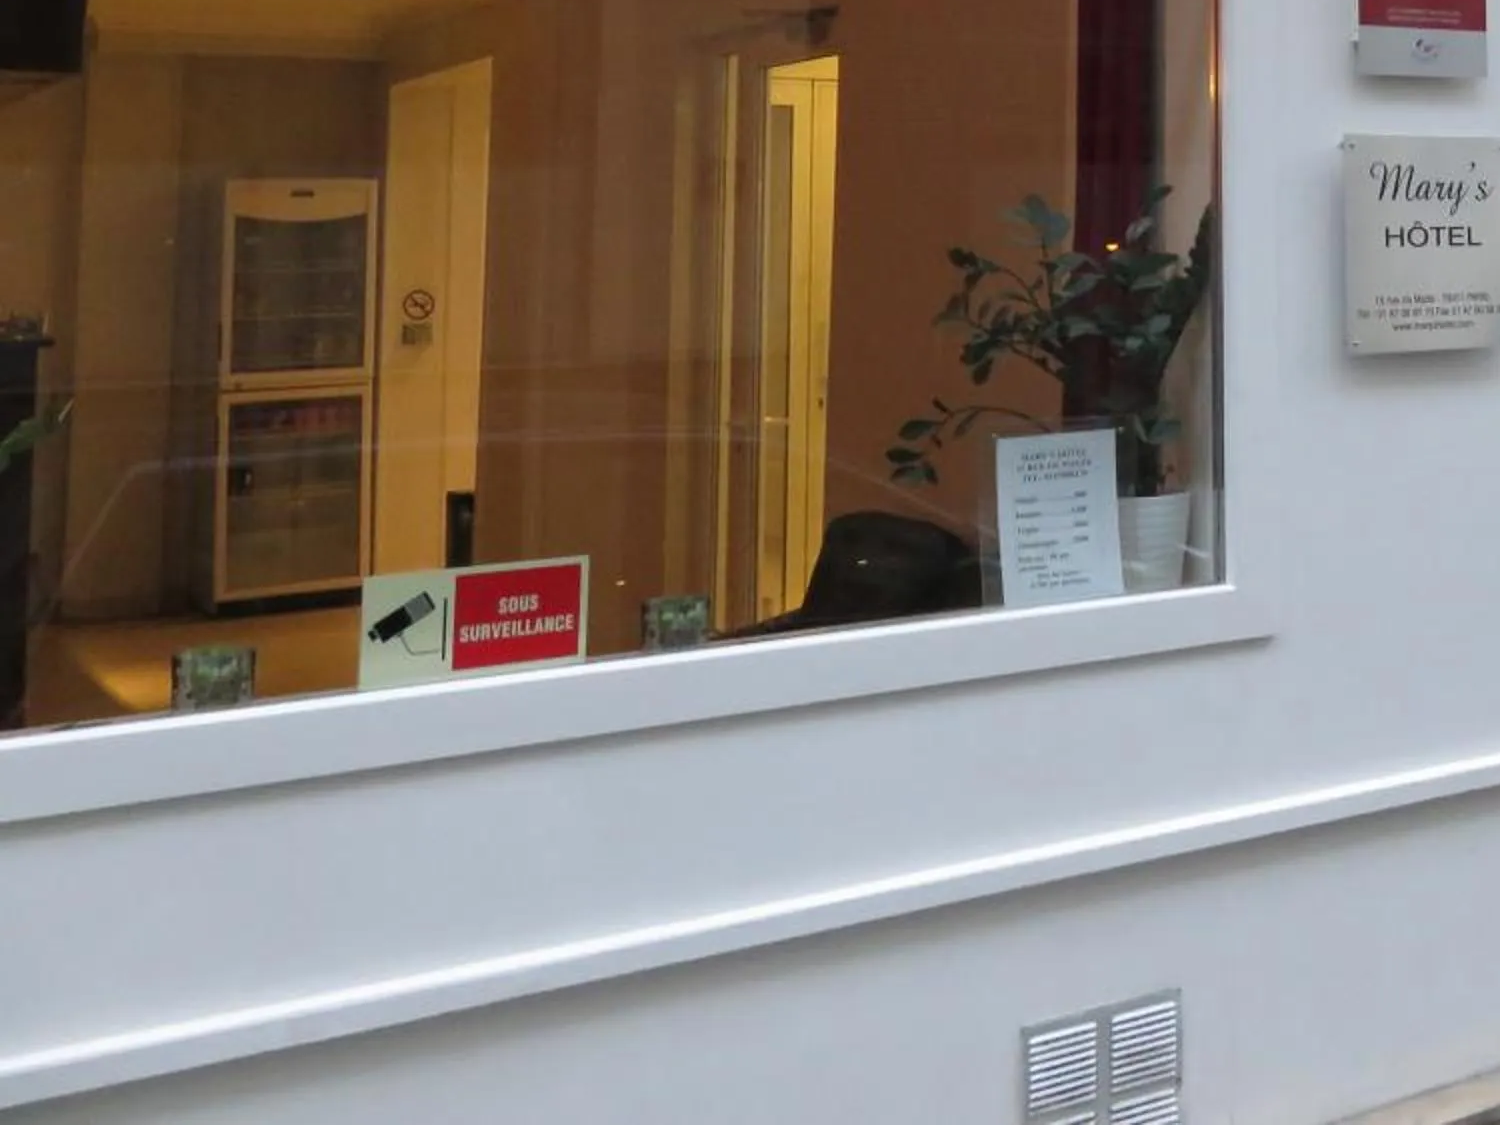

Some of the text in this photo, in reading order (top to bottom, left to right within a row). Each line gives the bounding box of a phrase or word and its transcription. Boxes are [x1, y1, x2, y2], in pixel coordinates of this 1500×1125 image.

[1369, 161, 1493, 216] Mary's
[1384, 220, 1483, 248] HÔTEL
[496, 593, 540, 614] SOUS
[459, 612, 575, 643] SURVEILLANCE
